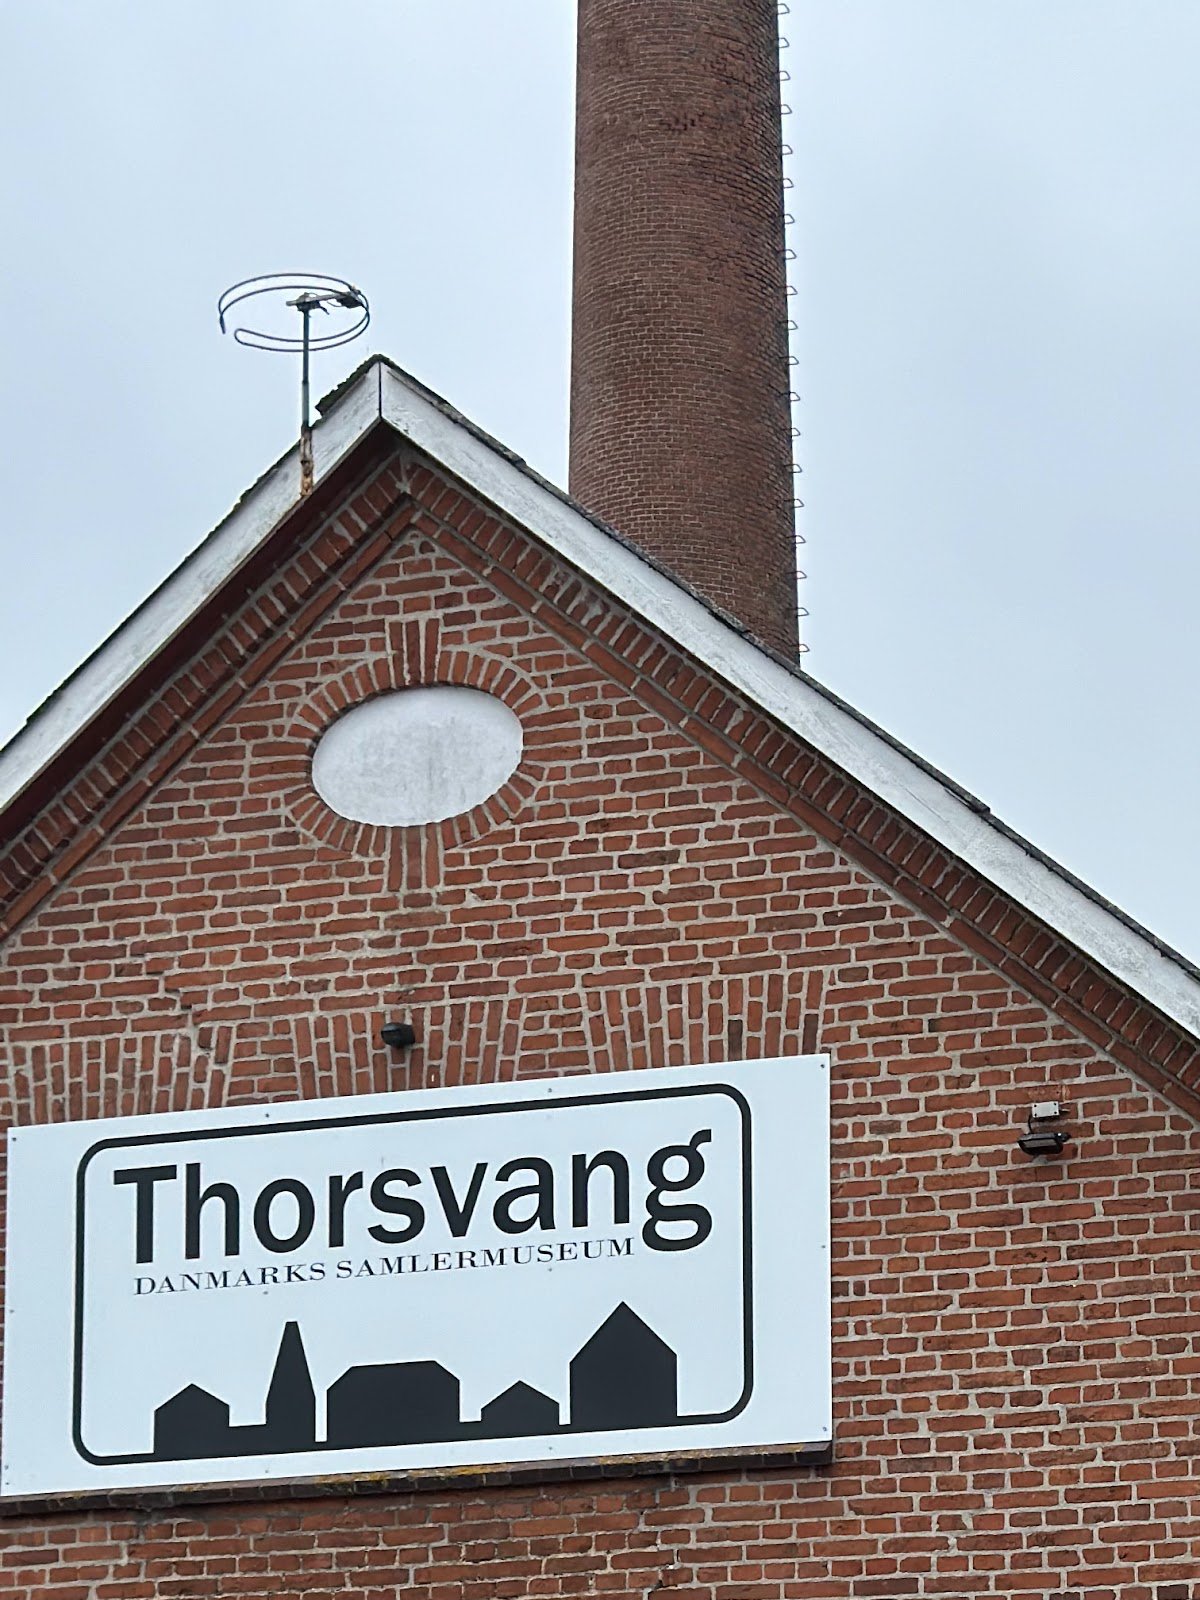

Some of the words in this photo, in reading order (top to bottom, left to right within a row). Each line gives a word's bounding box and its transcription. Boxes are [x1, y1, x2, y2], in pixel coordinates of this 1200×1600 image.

[112, 1128, 713, 1264] Thorsvang
[133, 1261, 327, 1296] DANMARKS
[336, 1237, 635, 1281] SAMLERMUSEUM
